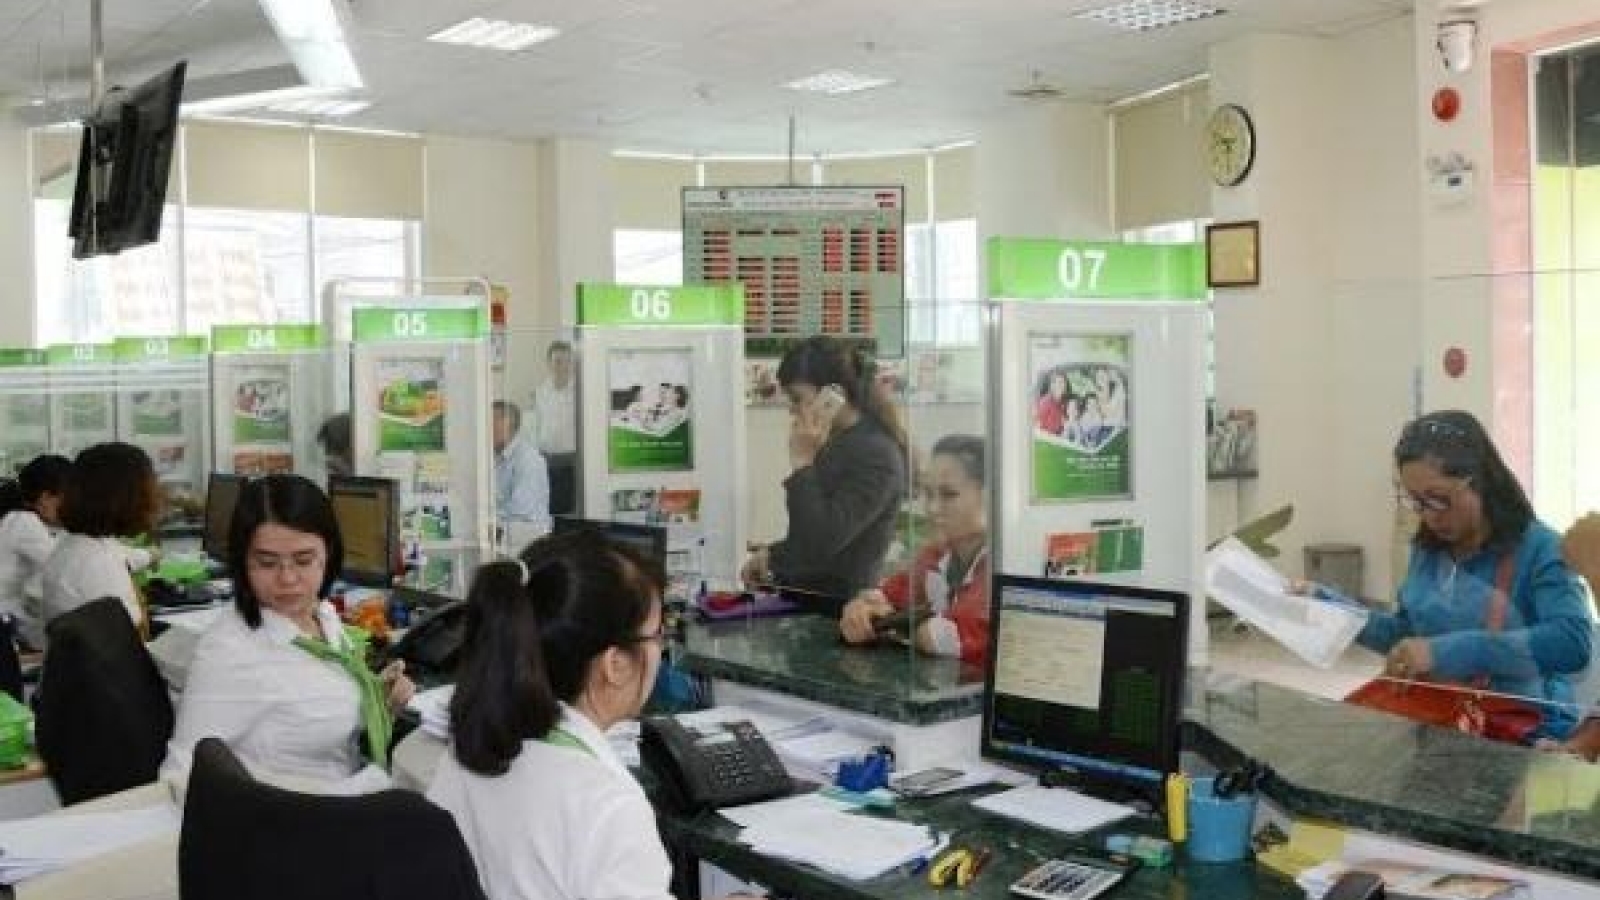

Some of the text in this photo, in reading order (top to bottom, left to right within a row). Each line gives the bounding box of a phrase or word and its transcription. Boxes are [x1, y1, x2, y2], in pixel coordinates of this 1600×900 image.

[1058, 247, 1107, 290] 07
[631, 288, 670, 320] 06
[393, 311, 427, 336] 05
[248, 328, 276, 349] 04
